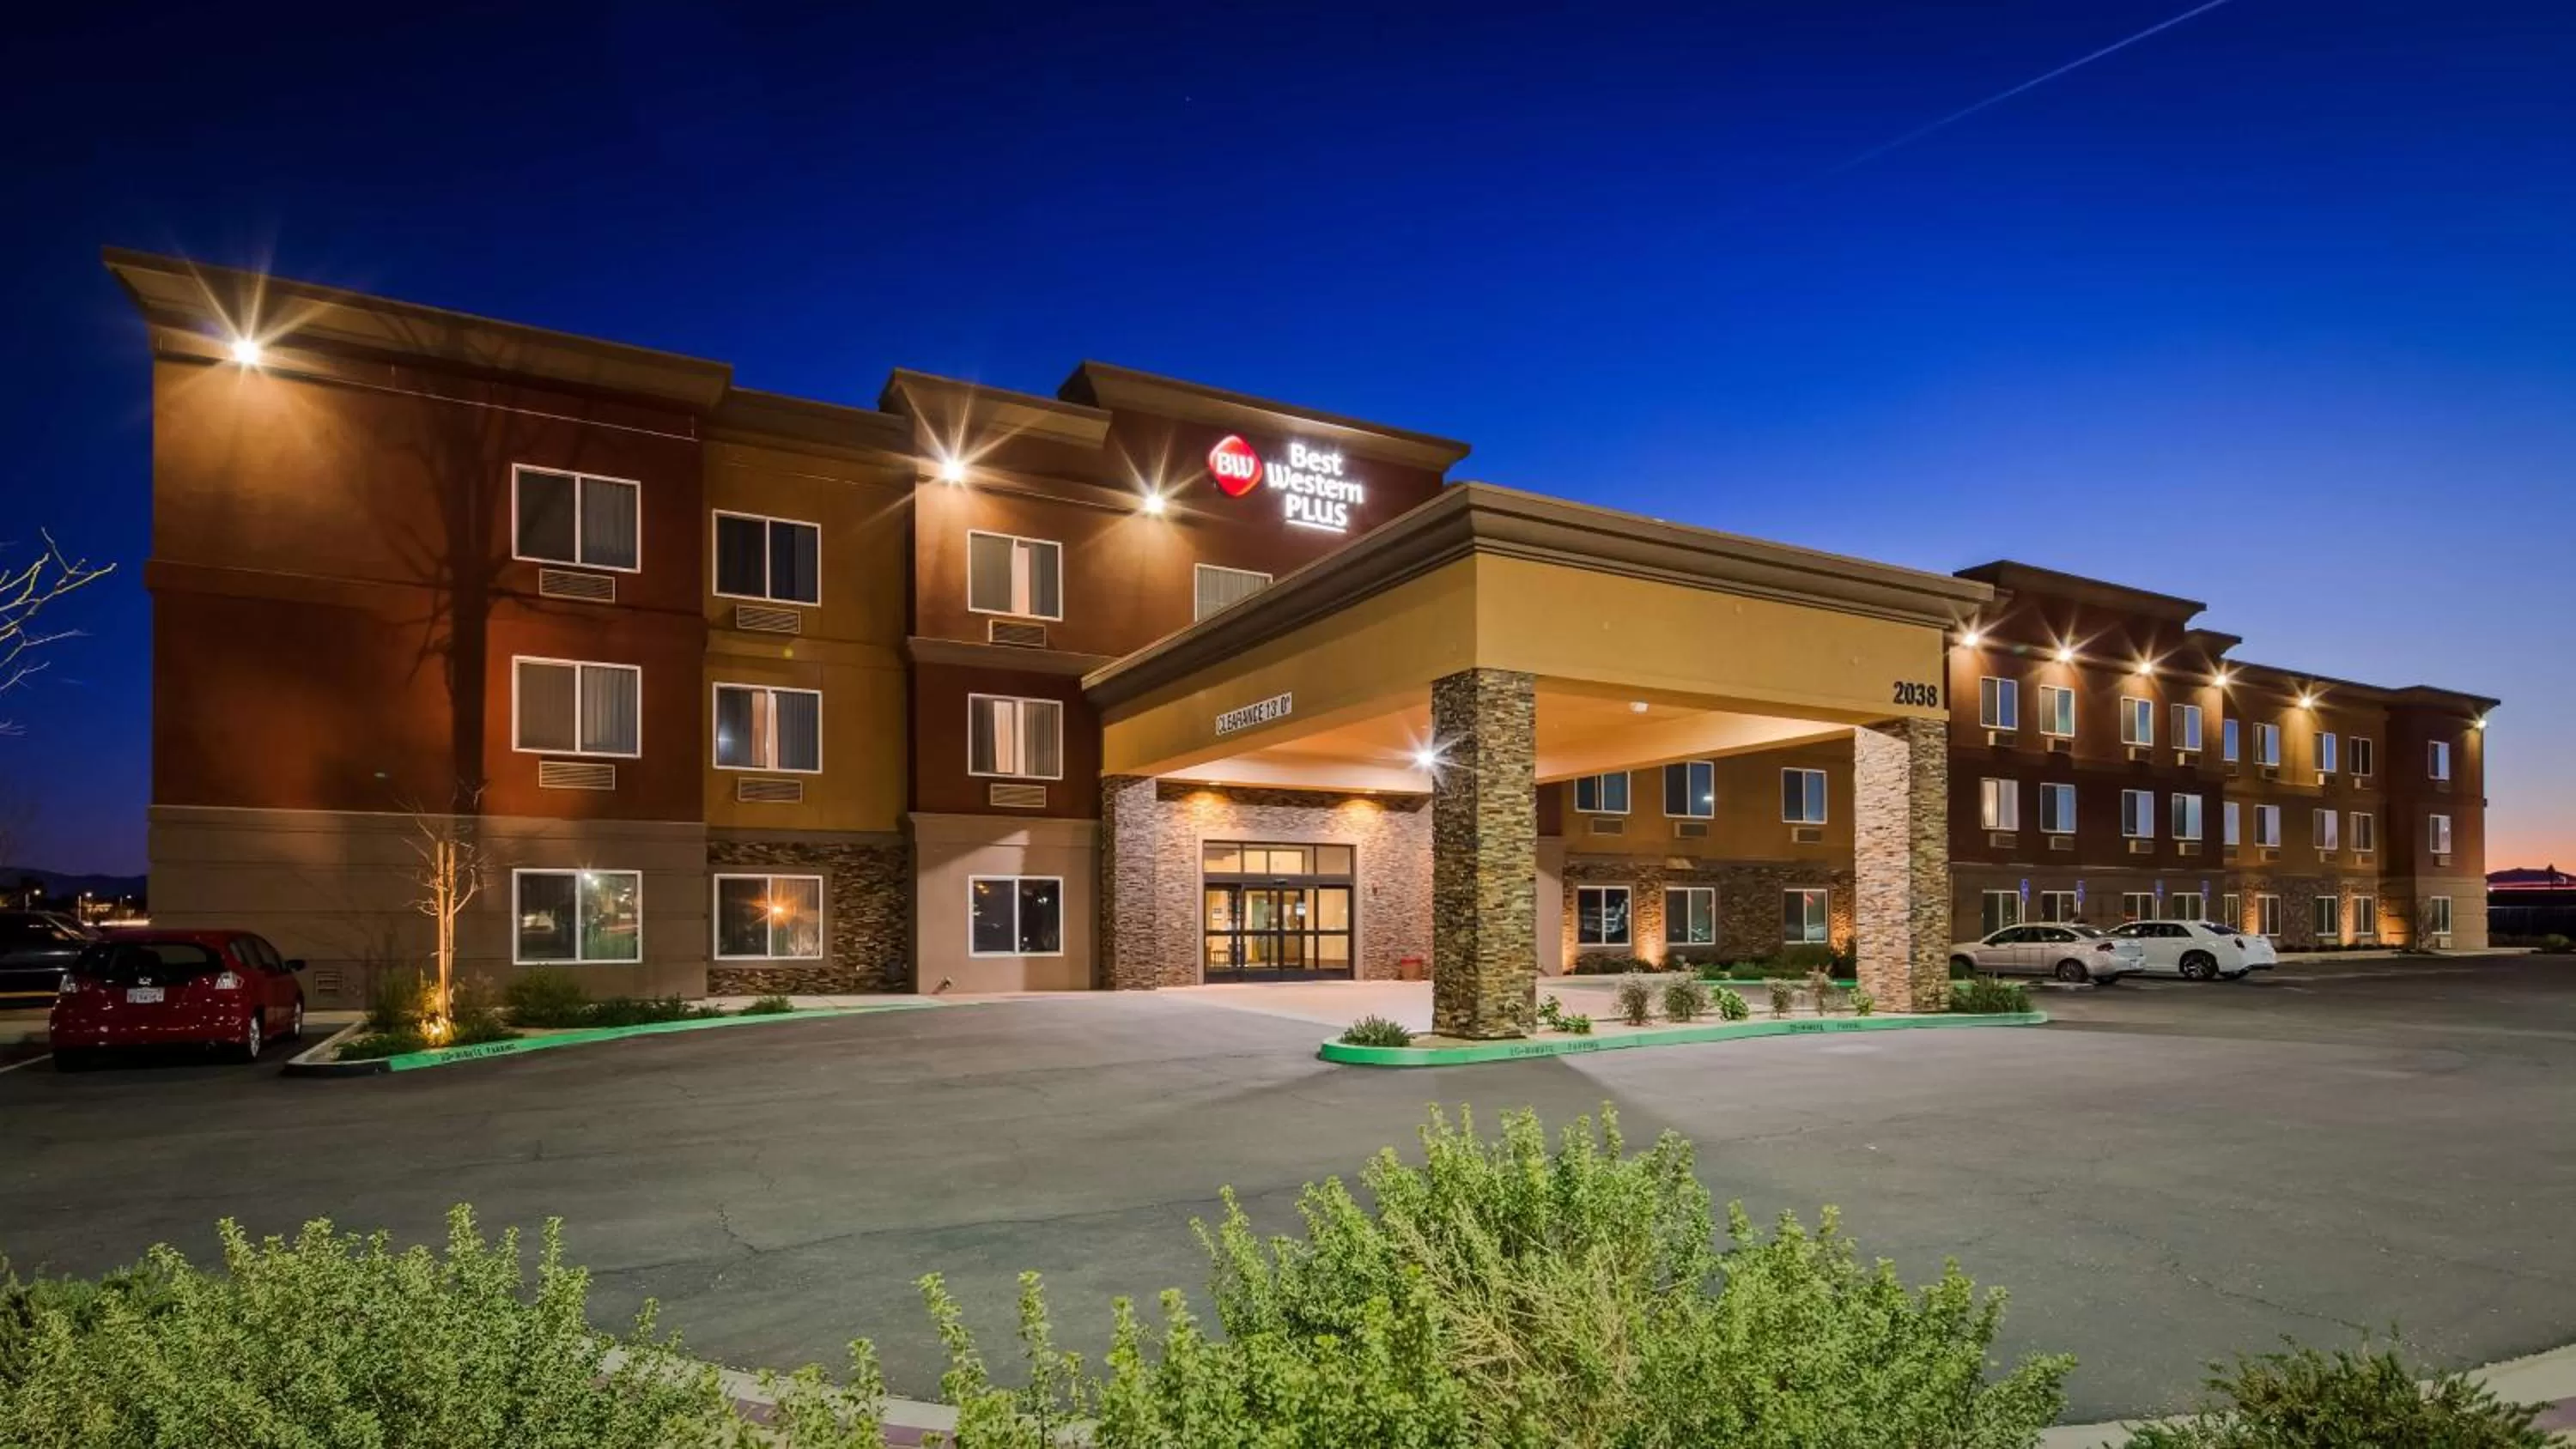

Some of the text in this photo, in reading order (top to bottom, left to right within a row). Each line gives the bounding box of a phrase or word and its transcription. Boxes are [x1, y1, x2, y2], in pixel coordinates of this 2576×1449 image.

[1217, 452, 1255, 479] BW
[1291, 442, 1342, 476] Best
[1266, 462, 1364, 504] Western
[1286, 494, 1347, 527] PLUS
[1893, 681, 1938, 708] 2038
[1218, 703, 1263, 732] CLEARANCE
